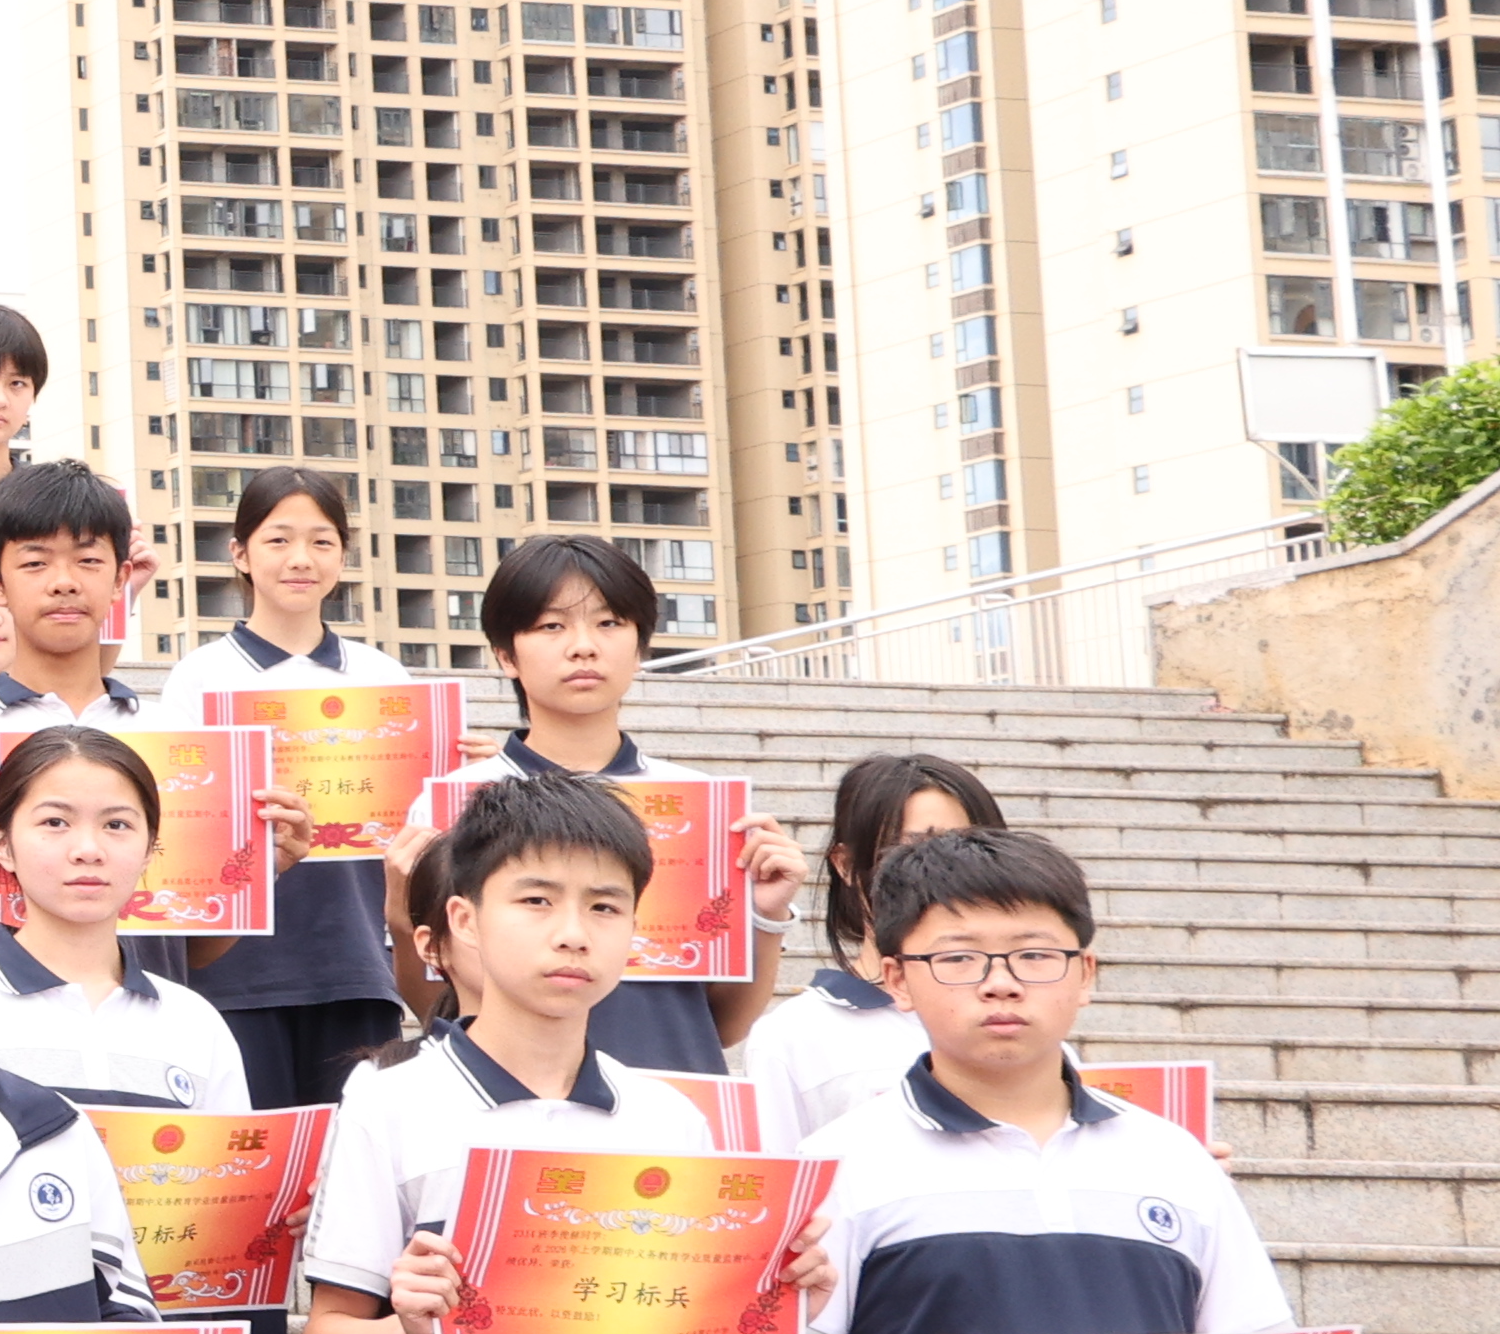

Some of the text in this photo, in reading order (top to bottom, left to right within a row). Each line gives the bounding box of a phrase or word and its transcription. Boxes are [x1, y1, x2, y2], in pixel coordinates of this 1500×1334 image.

[380, 696, 411, 715] 状
[168, 745, 206, 765] 状
[296, 778, 374, 796] 学习标兵
[645, 795, 683, 814] 状
[228, 1128, 268, 1152] 状
[719, 1174, 764, 1201] 状
[574, 1277, 690, 1308] 学习标兵
